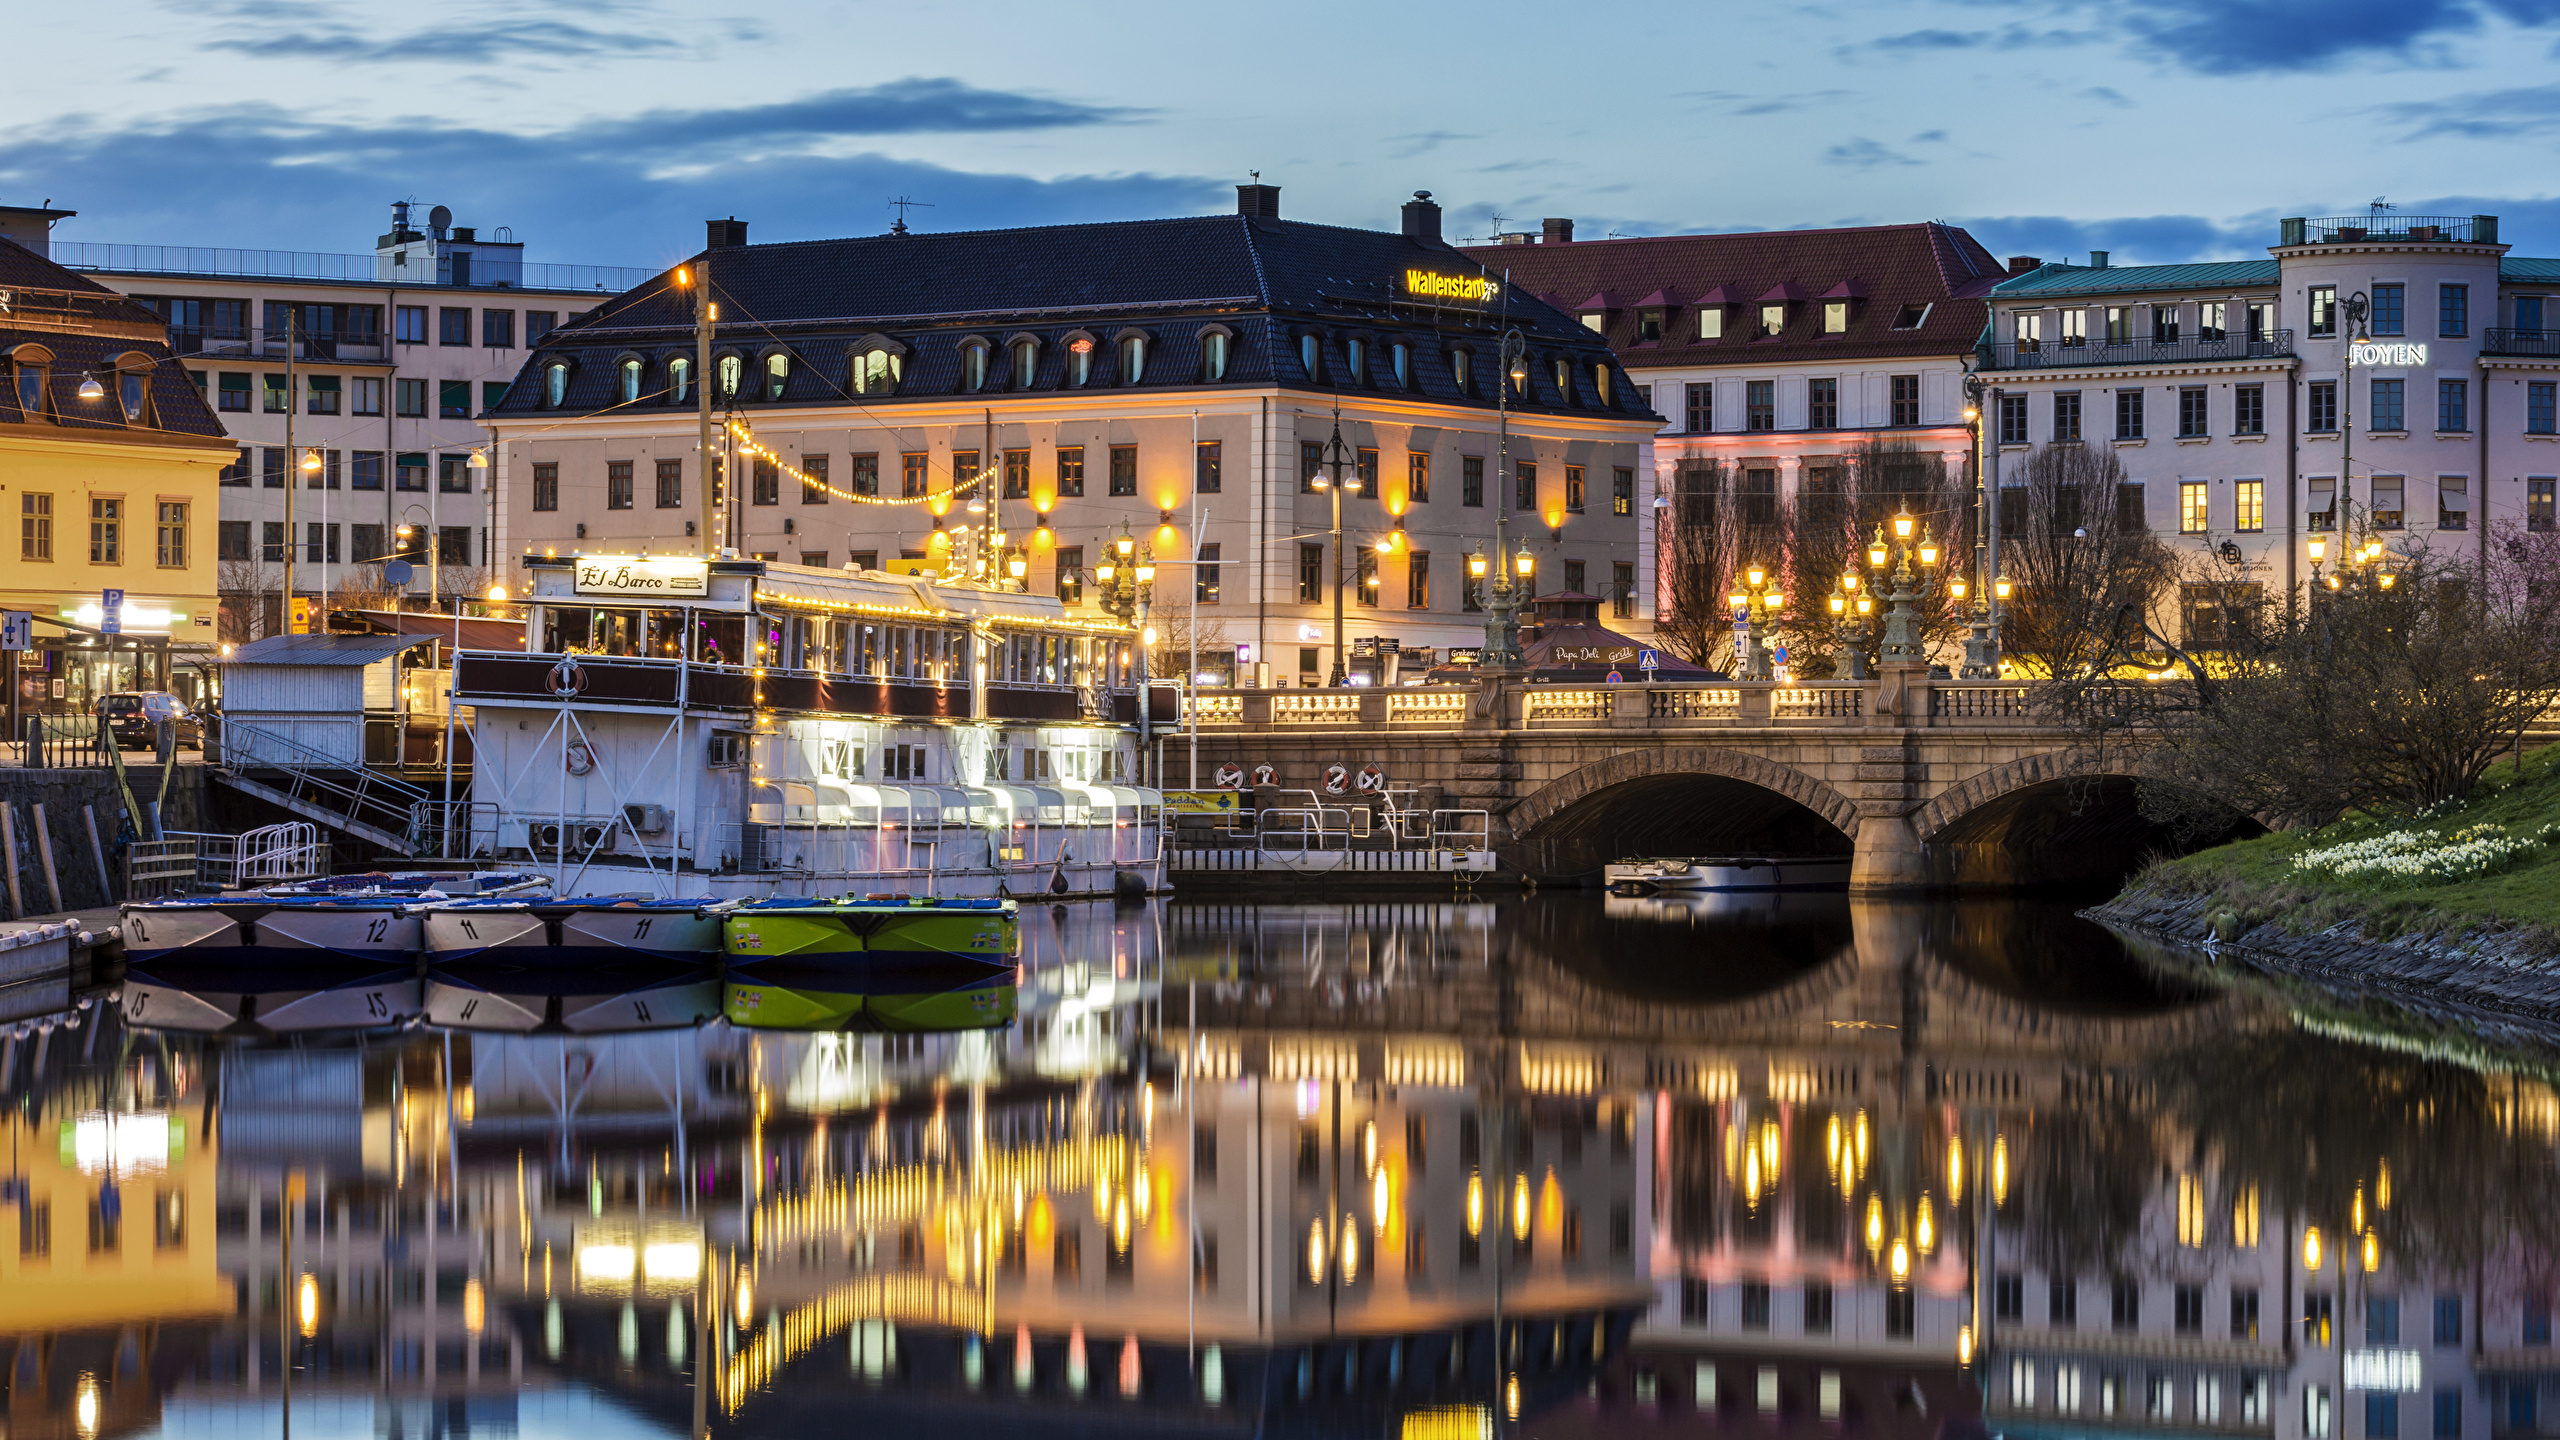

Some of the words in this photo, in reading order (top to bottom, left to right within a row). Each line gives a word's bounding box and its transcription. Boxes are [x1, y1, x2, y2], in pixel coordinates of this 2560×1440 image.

[1406, 269, 1485, 298] Wallenstam
[2350, 345, 2426, 365] FOYEN
[579, 566, 609, 587] El
[608, 566, 663, 589] Barco
[108, 590, 120, 606] P
[1556, 647, 1578, 662] Papa
[1580, 647, 1600, 661] Deli
[1608, 647, 1633, 661] Grill
[1163, 796, 1205, 805] Paddan
[131, 917, 151, 943] 12
[365, 918, 388, 943] 12
[460, 919, 479, 940] 11
[633, 918, 653, 940] 11
